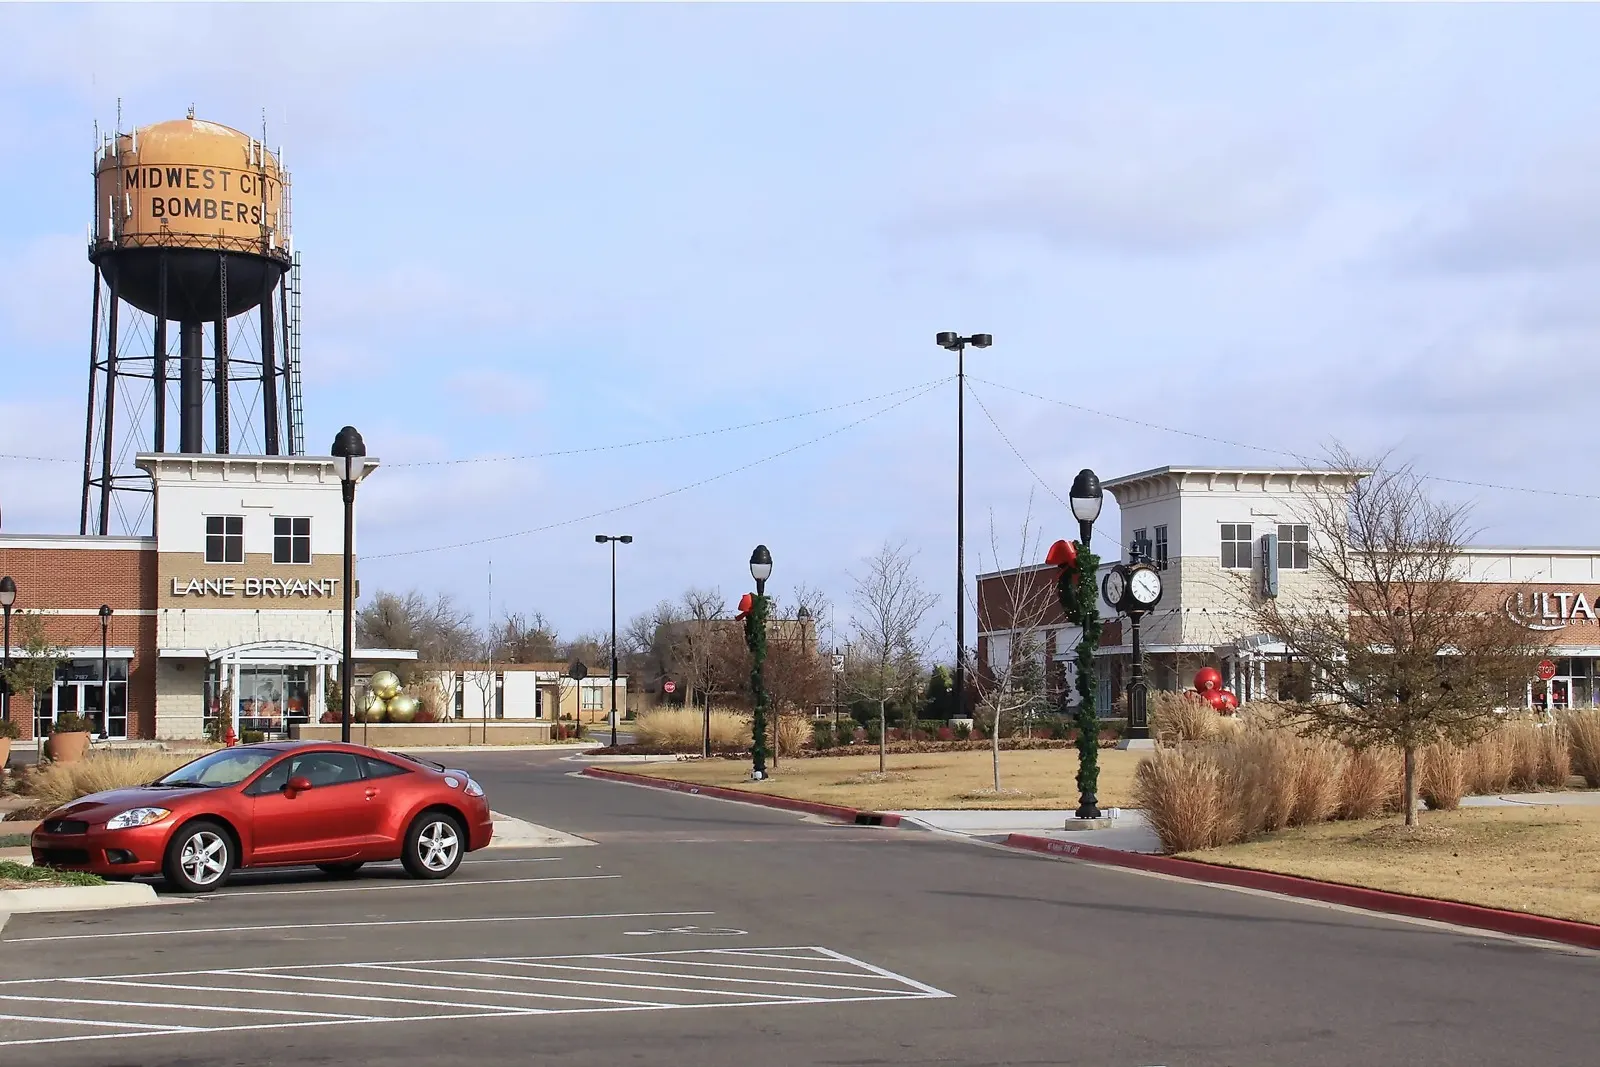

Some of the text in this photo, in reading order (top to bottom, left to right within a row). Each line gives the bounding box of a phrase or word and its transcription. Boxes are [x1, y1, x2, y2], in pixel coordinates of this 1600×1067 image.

[126, 168, 275, 201] MIDWEST CITY
[152, 197, 260, 225] BOMBERS
[173, 576, 340, 597] LANE BRYANT
[1517, 592, 1597, 618] ULTA
